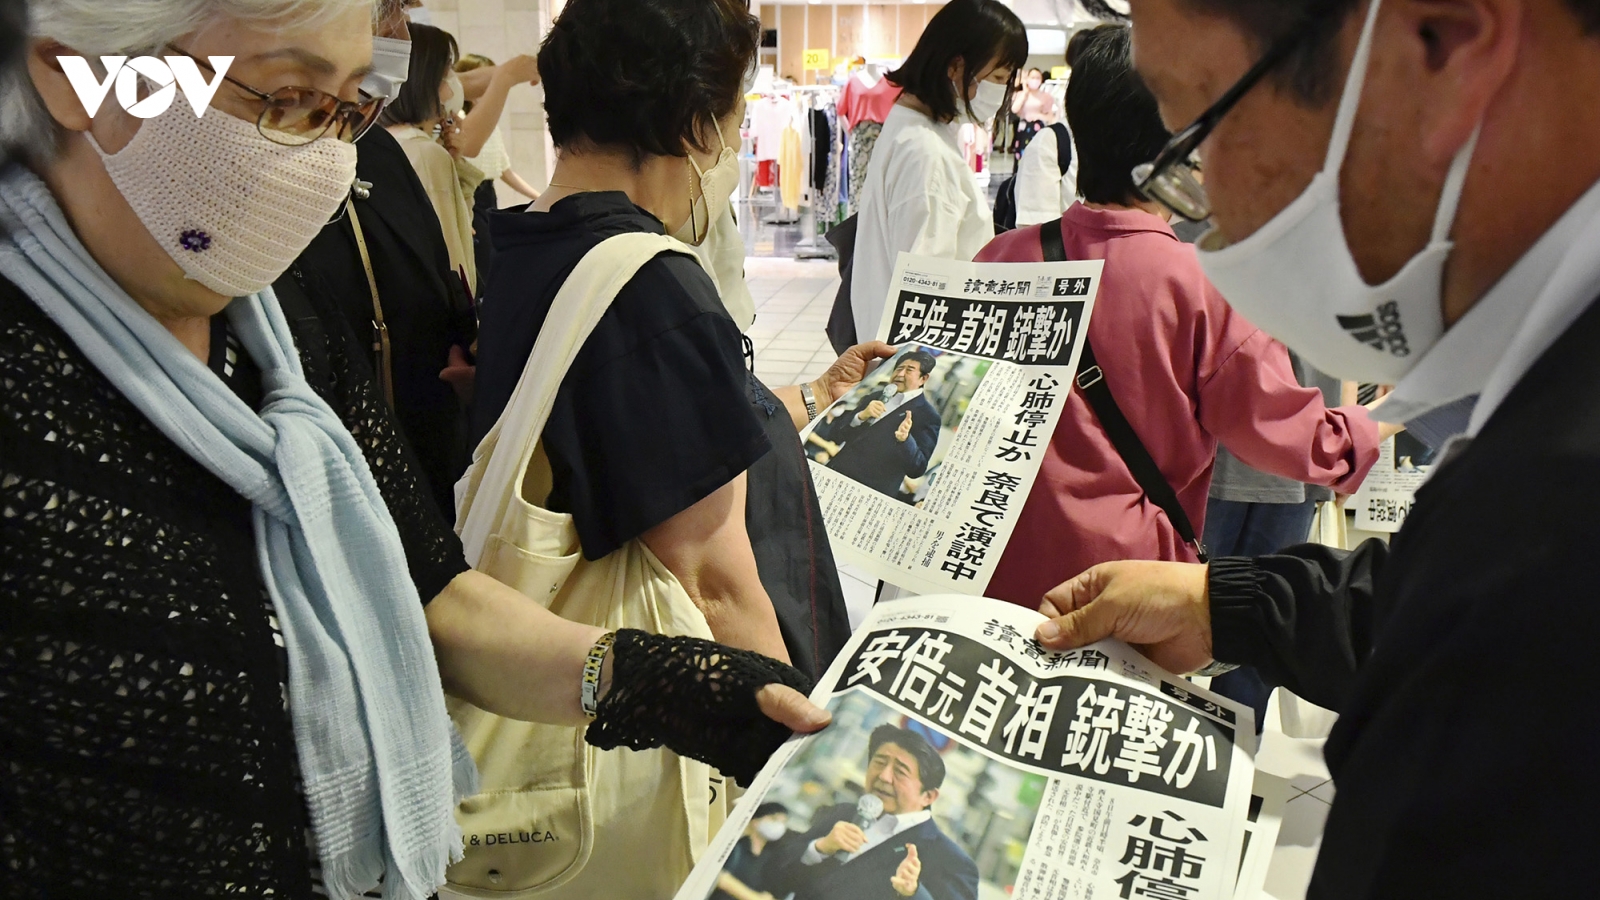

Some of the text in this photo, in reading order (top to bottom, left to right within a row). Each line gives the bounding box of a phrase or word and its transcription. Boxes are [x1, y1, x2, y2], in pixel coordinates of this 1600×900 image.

[1057, 279, 1085, 295] 号外
[893, 296, 1073, 362] 安倍元首相 銃撃か
[994, 372, 1059, 462] 心肺停止か
[940, 469, 1022, 581] 奈良で演説中
[847, 630, 1217, 790] 安倍元首相 銃撃か
[1170, 686, 1226, 717] 号外
[470, 834, 480, 846] &
